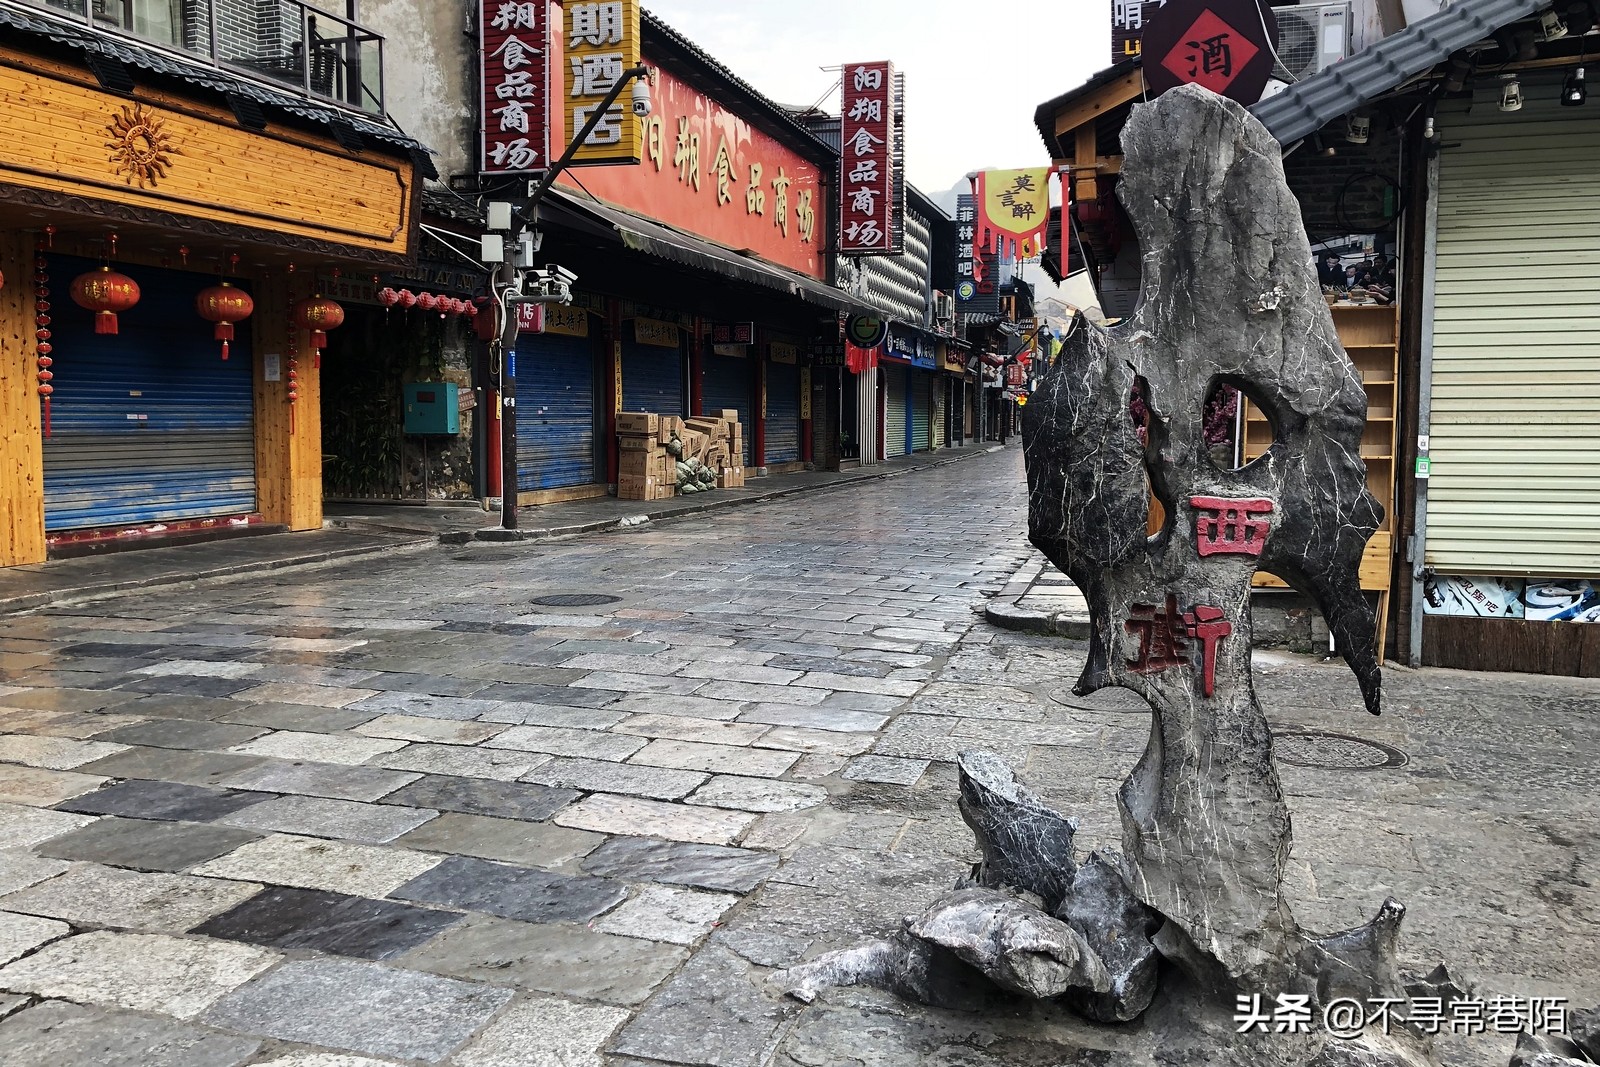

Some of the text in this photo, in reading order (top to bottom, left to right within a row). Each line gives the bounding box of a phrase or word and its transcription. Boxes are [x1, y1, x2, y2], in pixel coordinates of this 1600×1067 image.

[487, 1, 544, 170] 朔食品商场
[569, 1, 624, 146] 期酒店
[1184, 33, 1232, 78] 酒
[641, 114, 815, 244] 阳朔食品商场
[844, 65, 885, 248] 阳朔食品商场
[996, 174, 1036, 221] 莫言醉
[957, 207, 974, 276] 菲林酒吧
